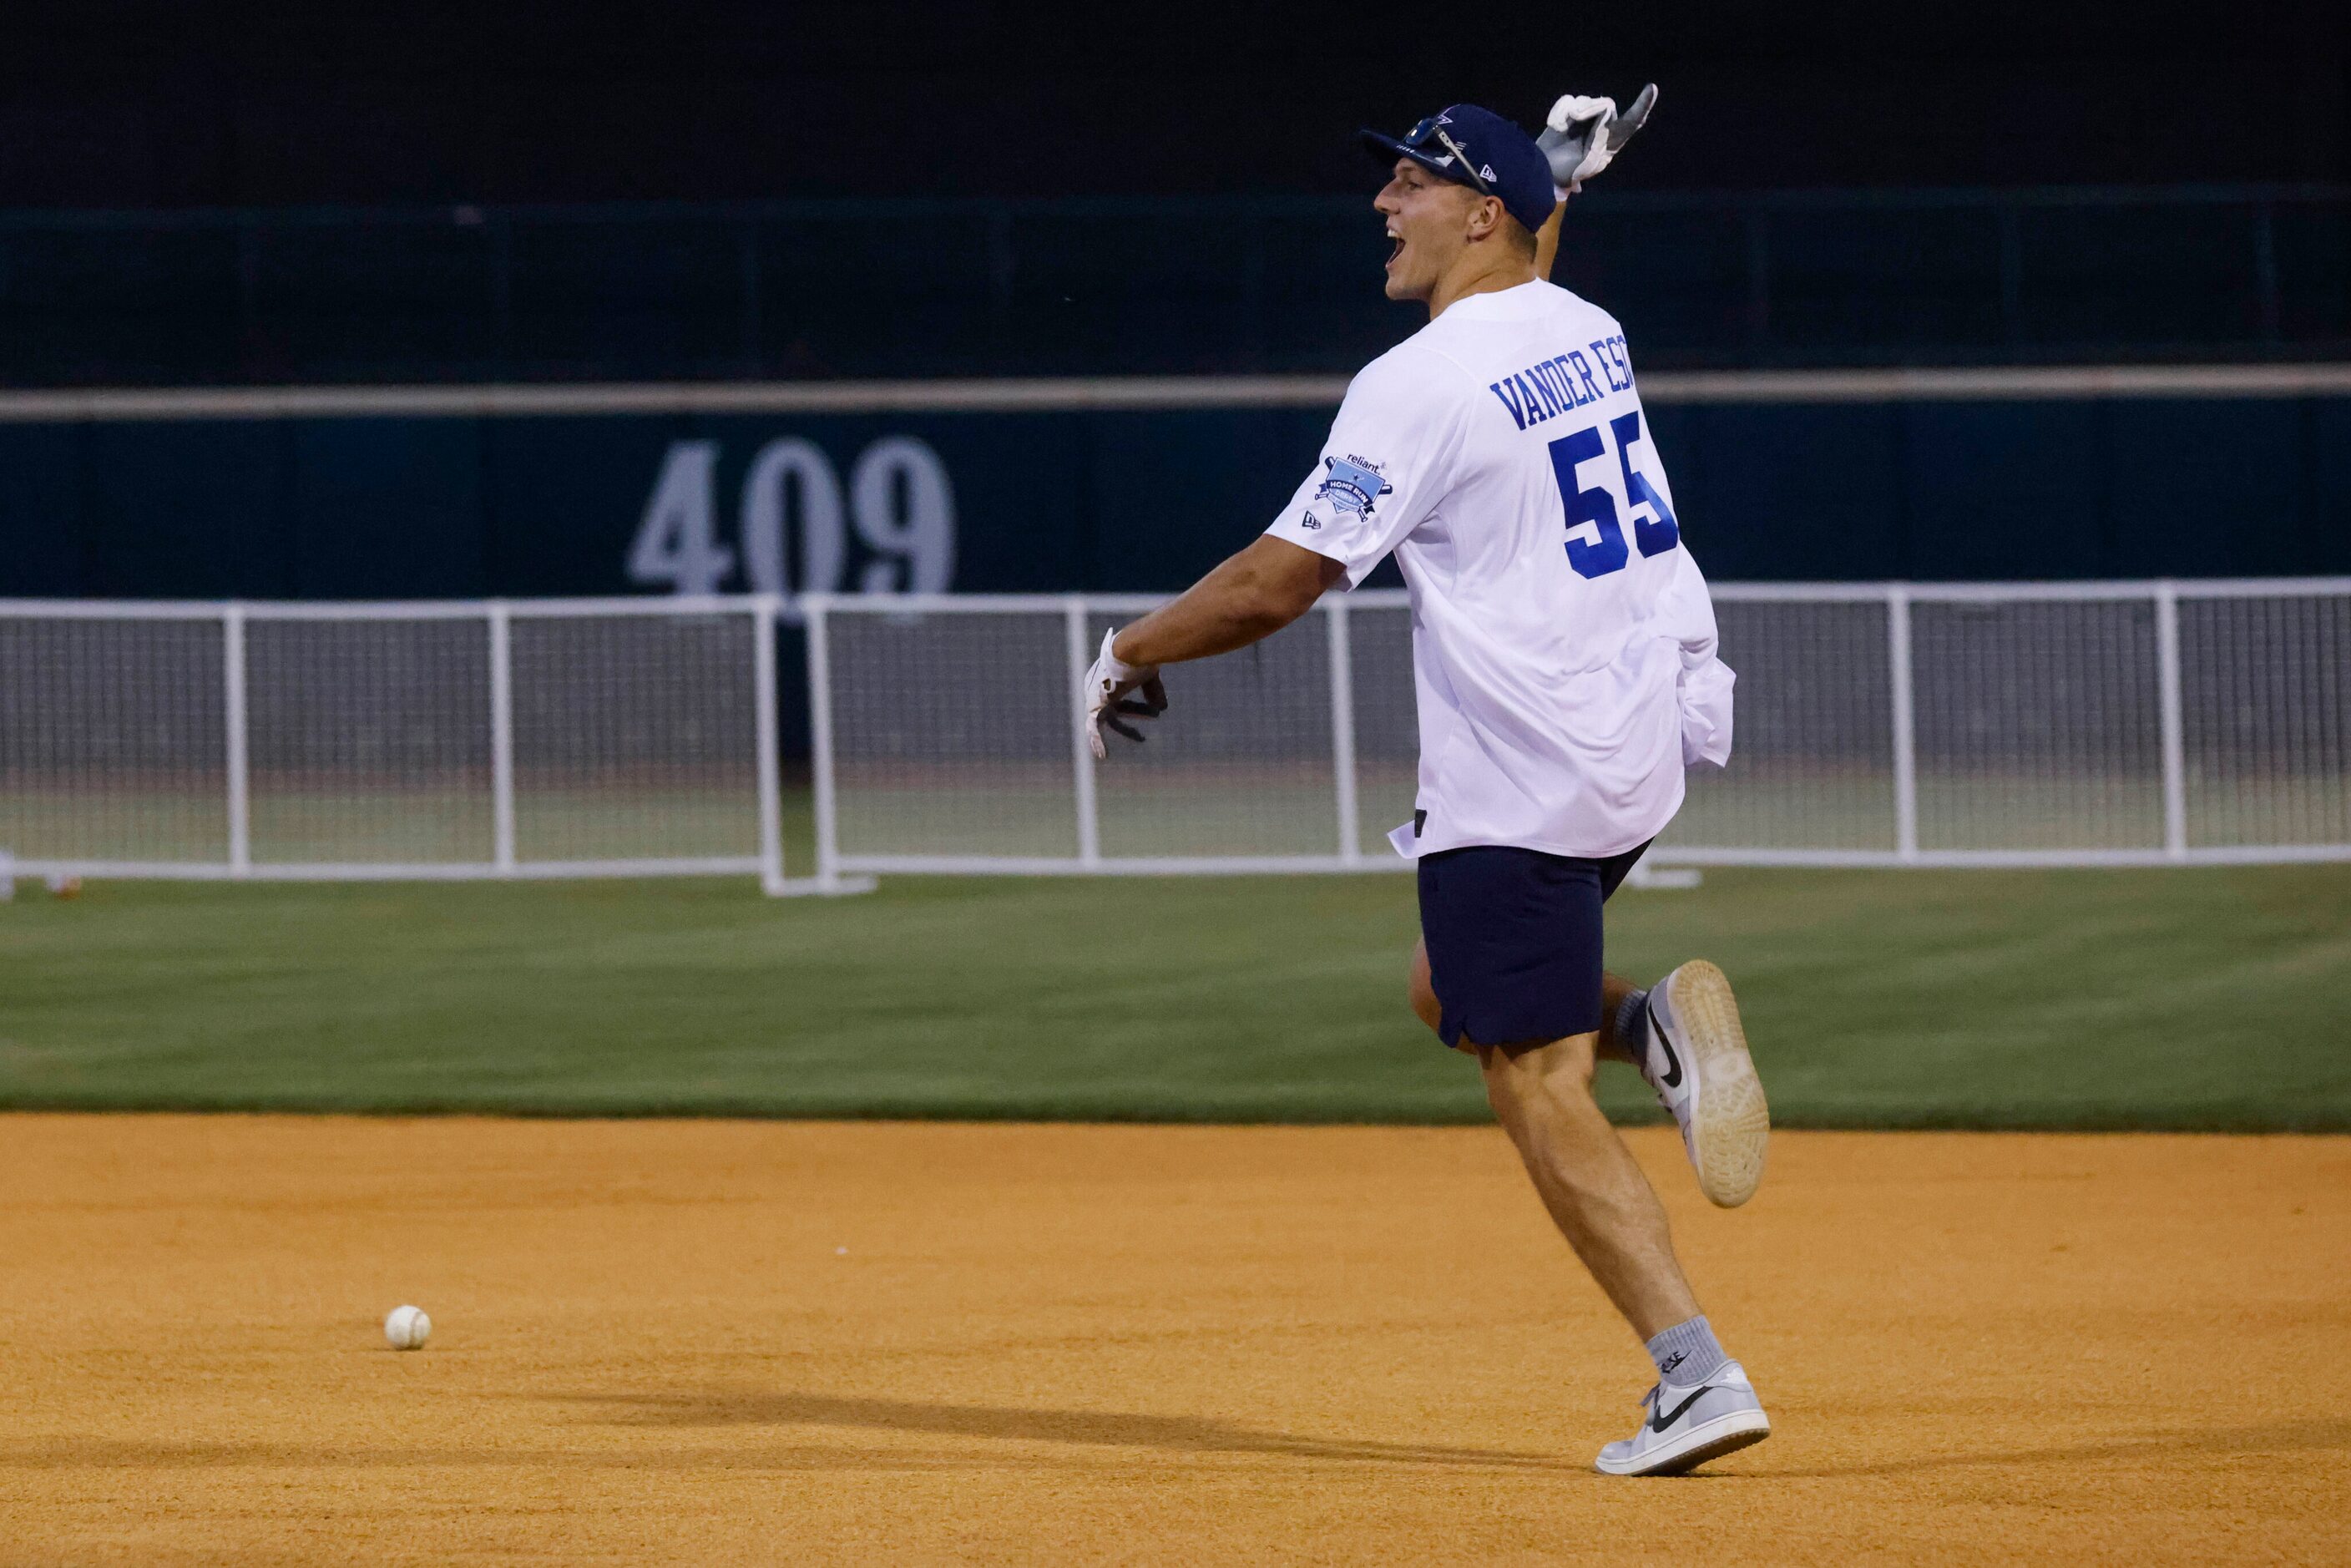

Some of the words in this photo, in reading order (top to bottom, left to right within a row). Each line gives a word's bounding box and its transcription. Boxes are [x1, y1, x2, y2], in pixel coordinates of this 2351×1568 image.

[1489, 350, 1605, 431] VANDER
[625, 435, 957, 620] 409
[1330, 481, 1354, 491] HOME
[1352, 488, 1369, 503] RUN
[1548, 411, 1679, 579] 55
